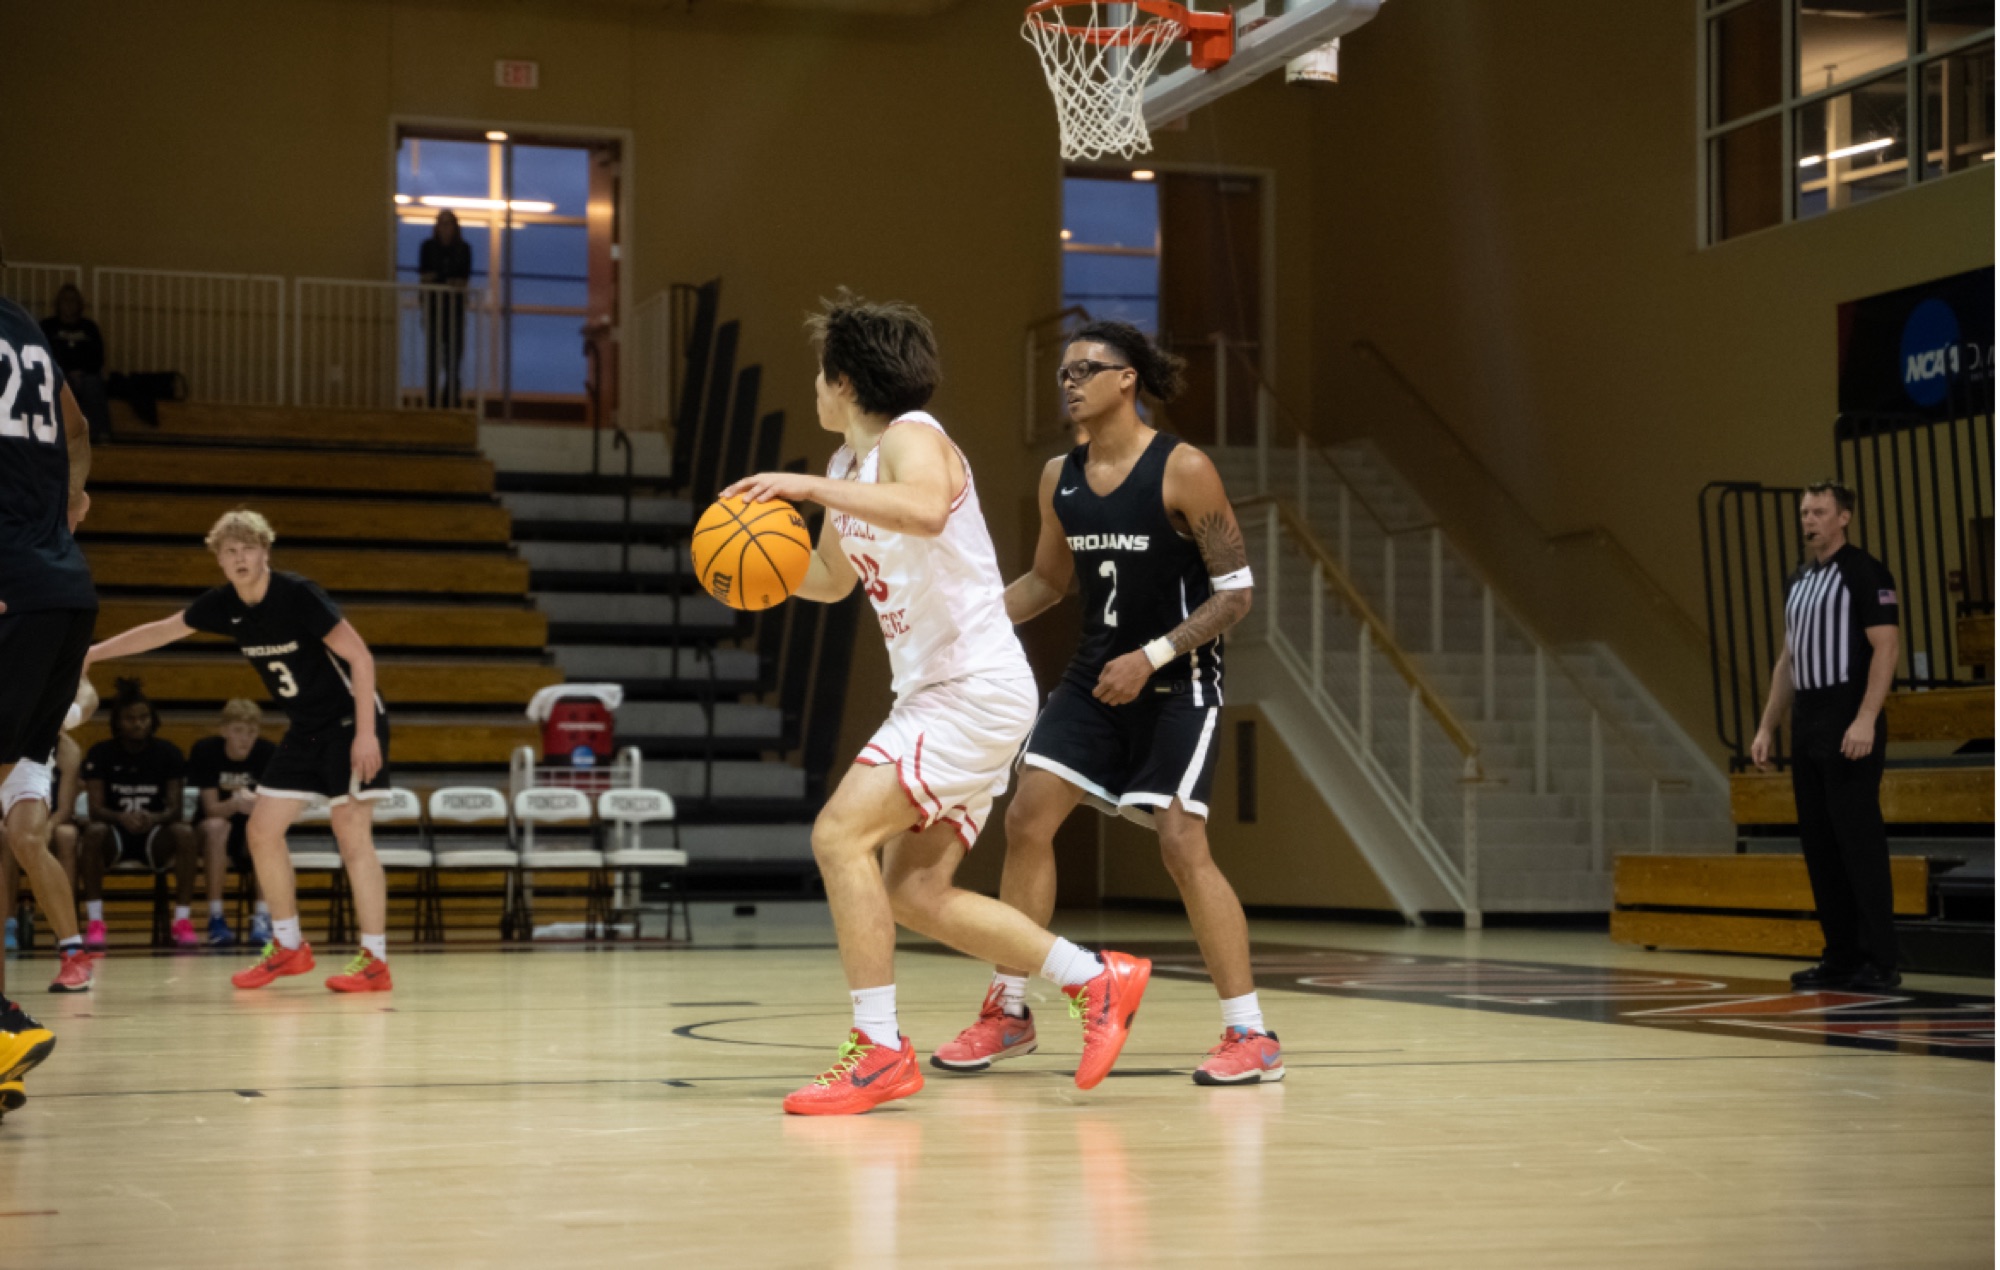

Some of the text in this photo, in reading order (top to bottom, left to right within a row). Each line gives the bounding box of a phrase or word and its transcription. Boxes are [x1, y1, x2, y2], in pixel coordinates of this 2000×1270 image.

[0, 339, 57, 443] 23
[1066, 534, 1150, 551] TROJANS
[1099, 560, 1118, 627] 2
[268, 661, 298, 697] 3
